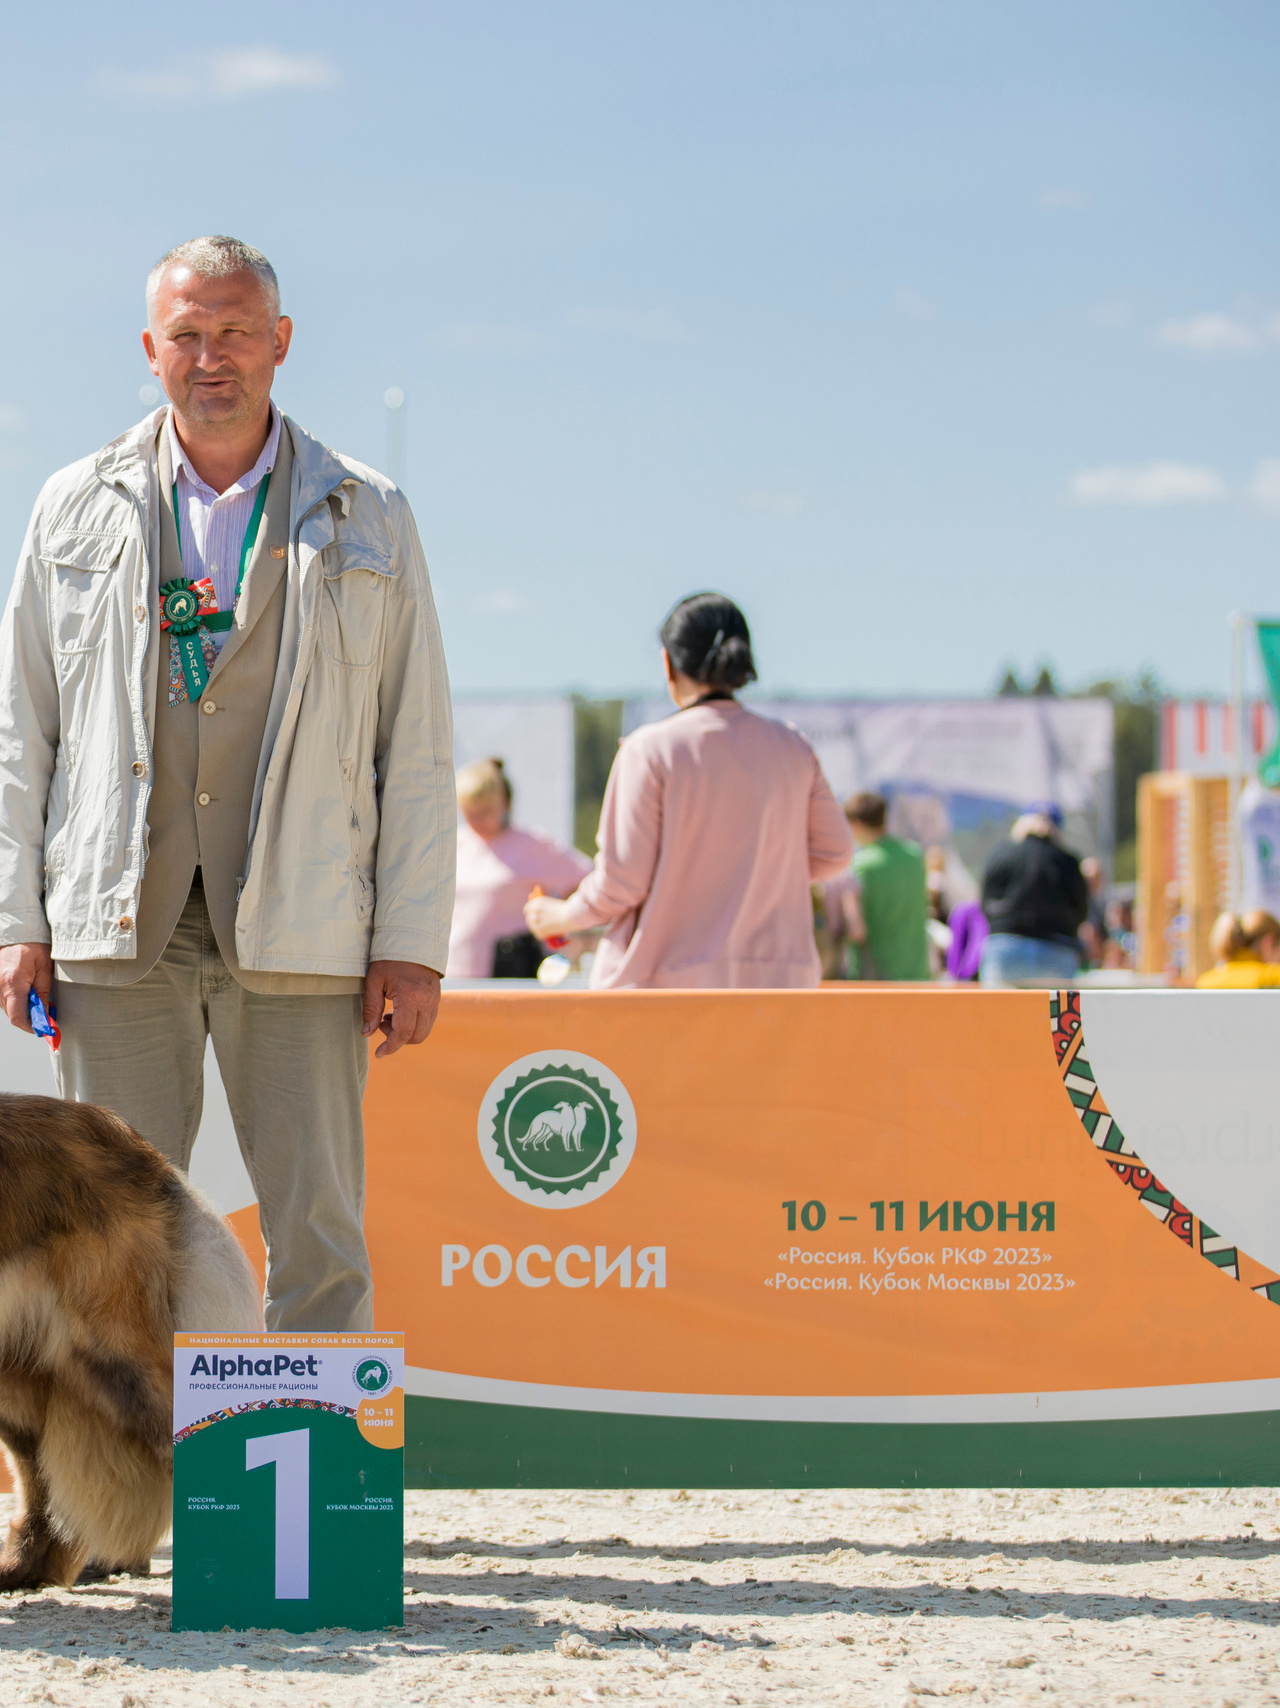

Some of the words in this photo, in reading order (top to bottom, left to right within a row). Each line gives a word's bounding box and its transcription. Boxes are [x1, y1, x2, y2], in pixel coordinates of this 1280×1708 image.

[186, 641, 201, 686] СУДЬЯ
[782, 1200, 826, 1231] 10
[870, 1200, 904, 1231] 11
[919, 1200, 1056, 1232] ИЮНЯ
[441, 1244, 667, 1288] РОССИЯ
[777, 1247, 867, 1265] «Россия.
[873, 1246, 936, 1270] Кубок
[941, 1247, 987, 1265] РКФ
[992, 1247, 1052, 1265] 2023»
[763, 1273, 853, 1291] «Россия.
[858, 1272, 921, 1295] Кубок
[927, 1273, 1010, 1291] Москвы
[1016, 1273, 1076, 1291] 2023»
[279, 1383, 318, 1391] РАЦИОНЫ
[364, 1408, 376, 1416] 10
[385, 1408, 394, 1416] 11
[364, 1419, 394, 1427] ИЮНЯ
[245, 1428, 310, 1599] 1
